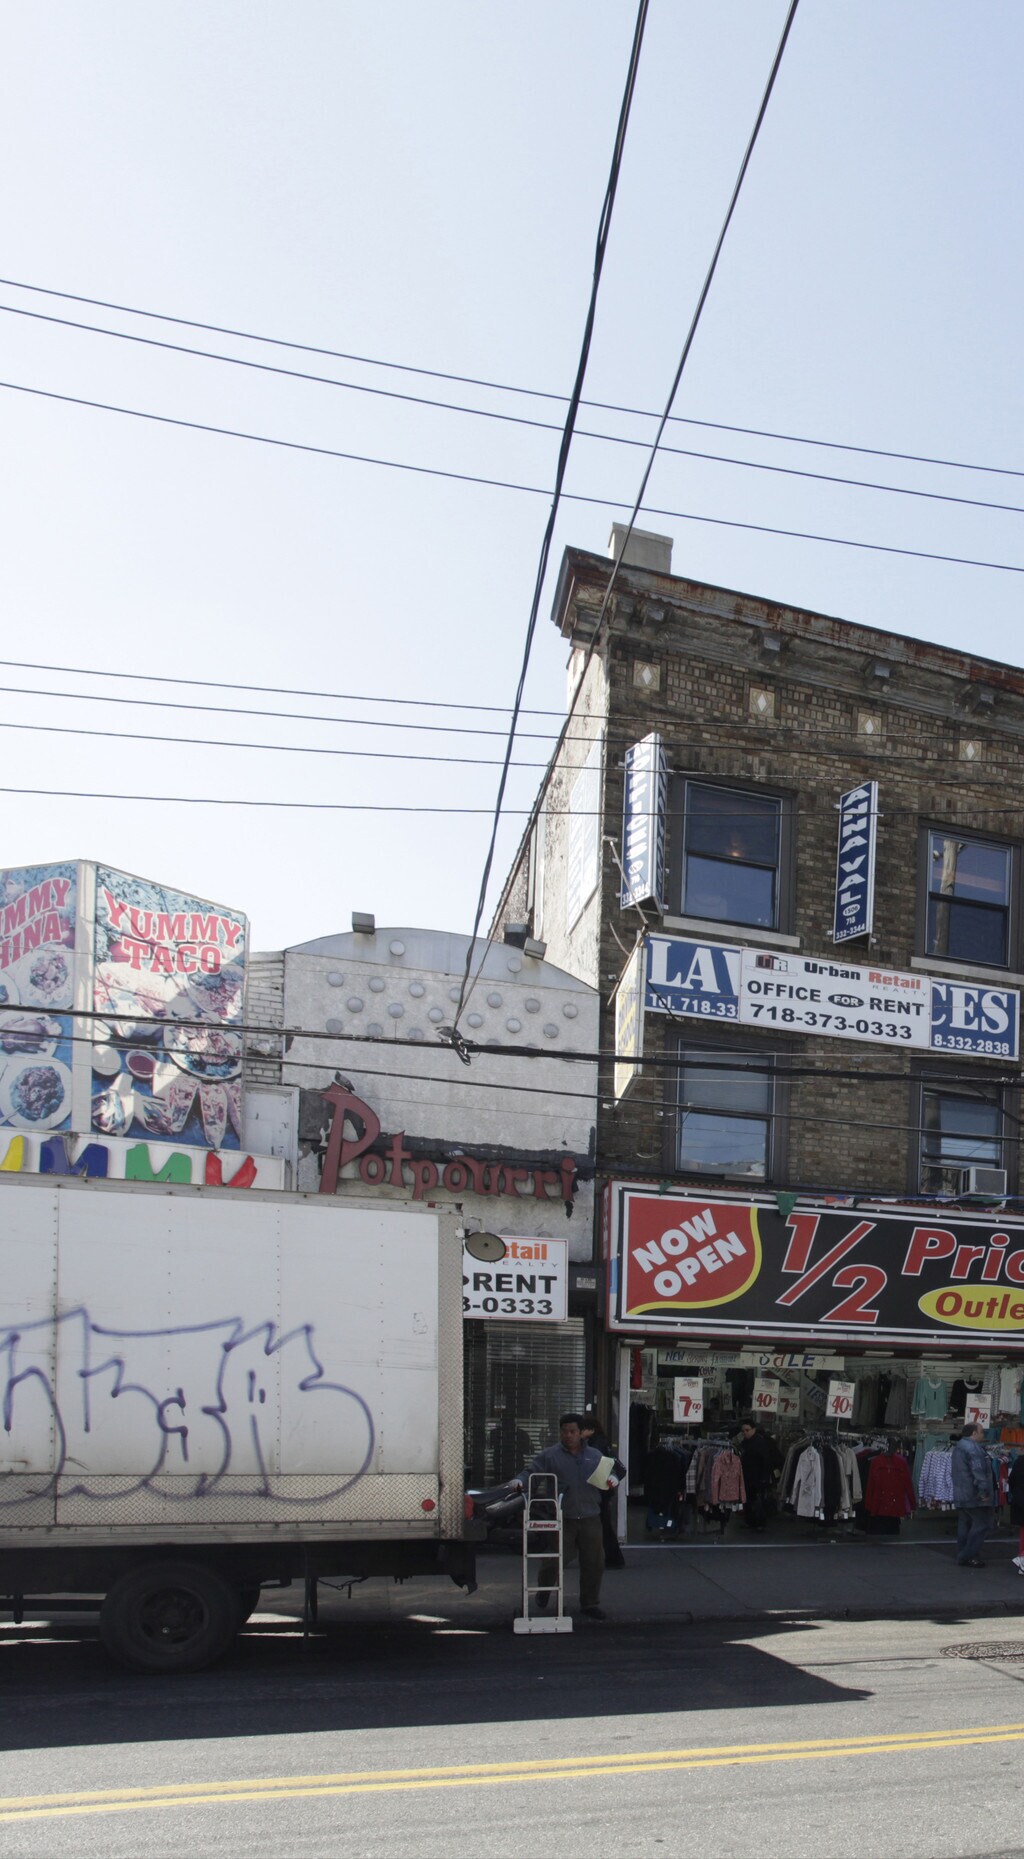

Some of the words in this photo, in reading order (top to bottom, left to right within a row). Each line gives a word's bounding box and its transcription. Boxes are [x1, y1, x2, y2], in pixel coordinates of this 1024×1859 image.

[0, 878, 71, 935] MMY
[104, 888, 242, 948] YUMMY
[846, 916, 856, 925] 718
[836, 923, 865, 939] 332-3344
[121, 935, 222, 975] TACO
[804, 961, 860, 982] Urban
[869, 971, 921, 990] Retail
[872, 985, 928, 997] REALTY
[681, 999, 738, 1018] 718-33
[747, 980, 822, 1003] OFFICE
[833, 995, 860, 1008] FOR
[869, 997, 925, 1016] RENT
[750, 1003, 912, 1040] 718-373-0333
[319, 1082, 575, 1200] Potpourri
[503, 1242, 548, 1260] tail
[632, 1209, 717, 1272] NOW
[654, 1231, 747, 1297] OPEN
[473, 1272, 558, 1294] RENT
[665, 1351, 685, 1361] NEW
